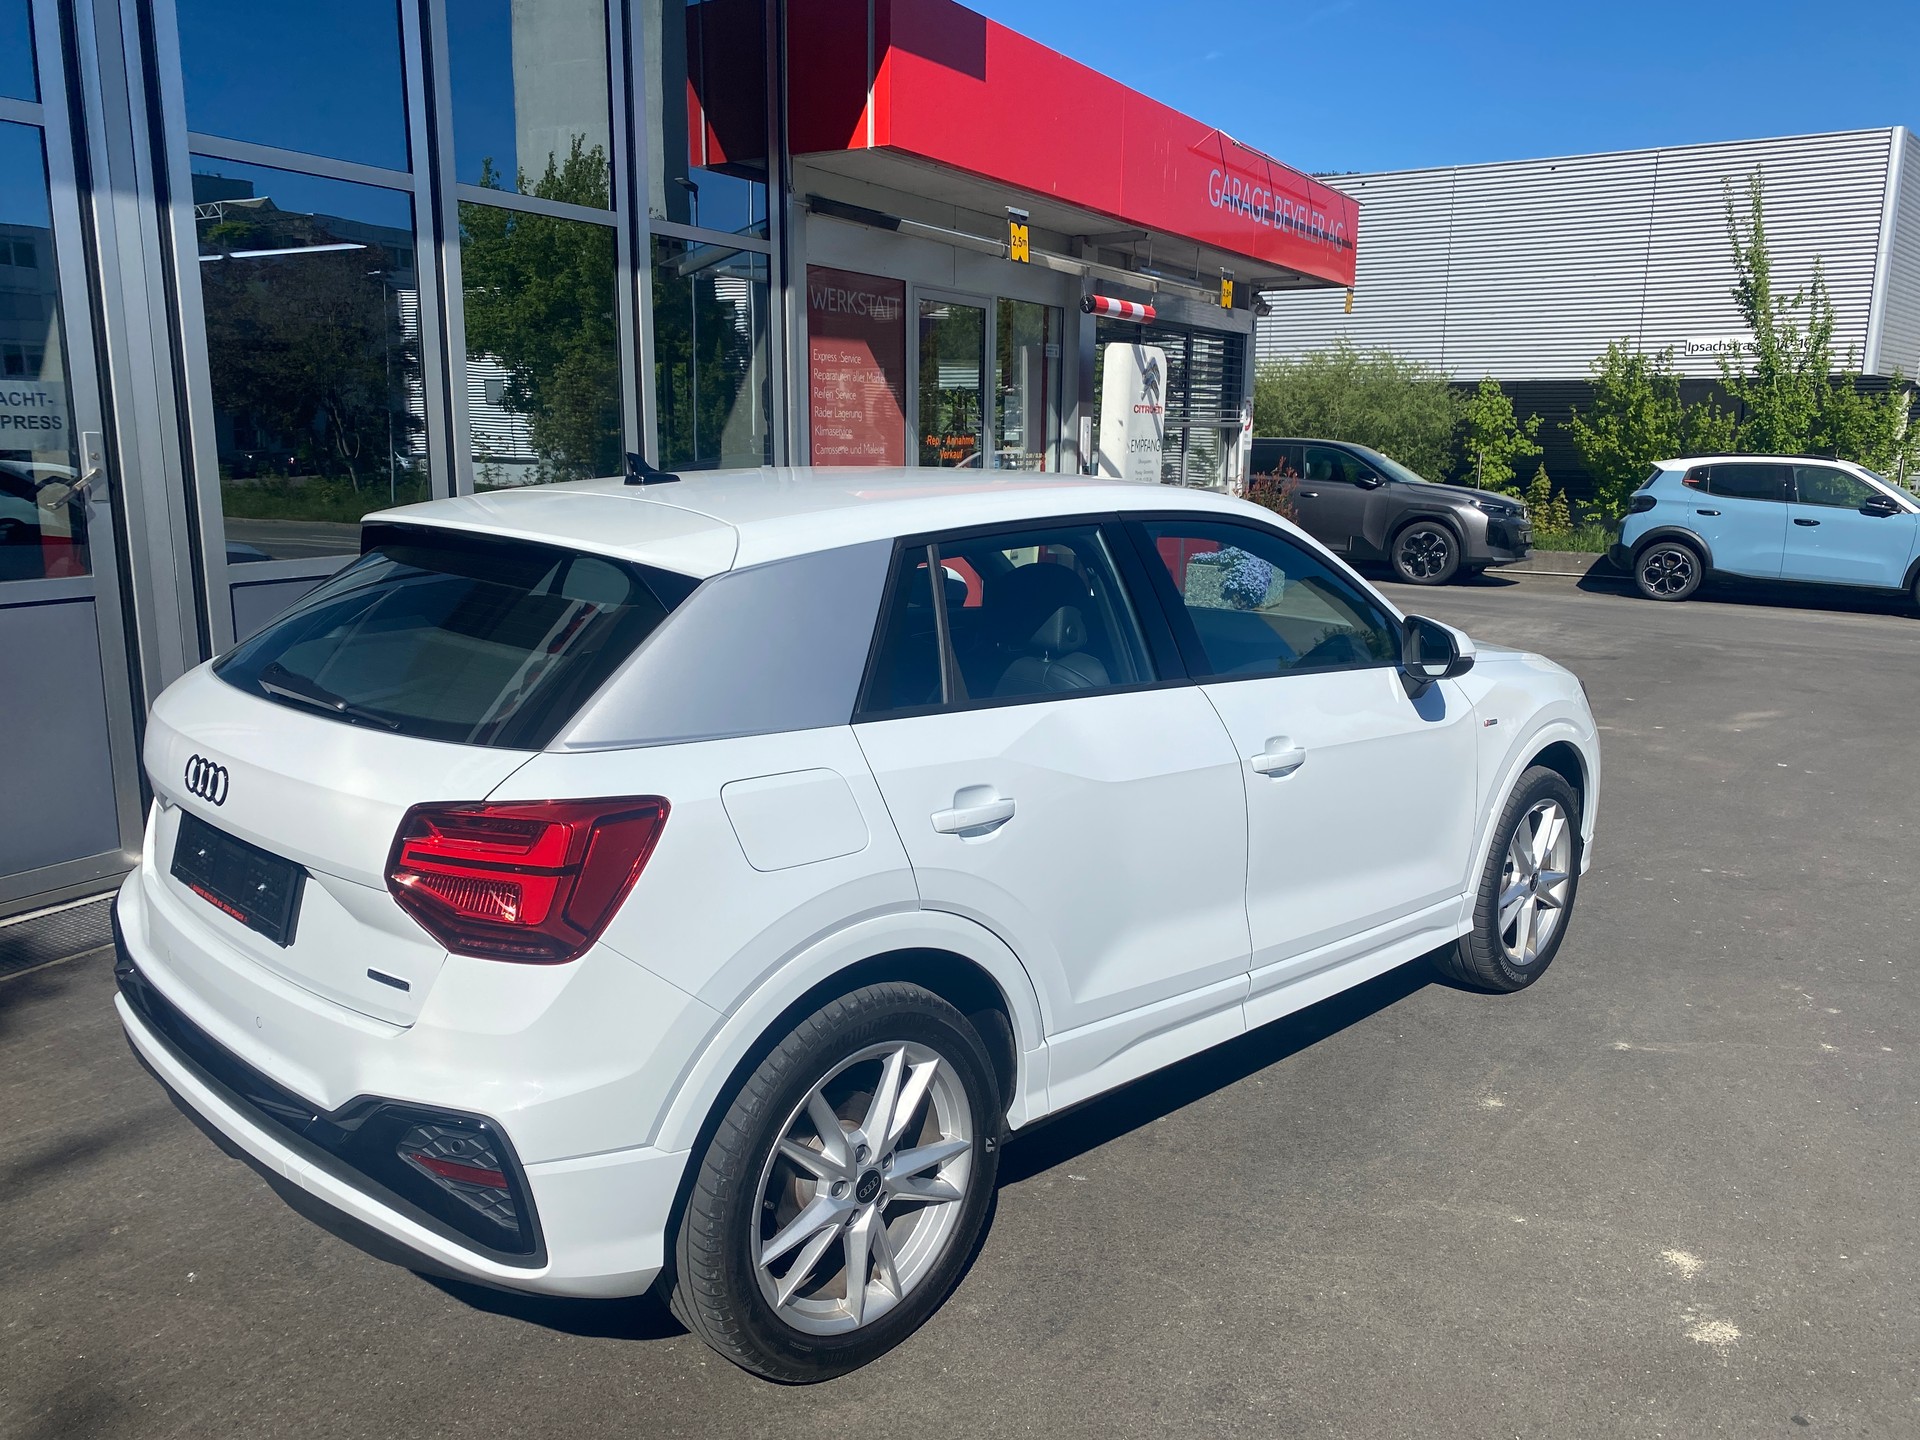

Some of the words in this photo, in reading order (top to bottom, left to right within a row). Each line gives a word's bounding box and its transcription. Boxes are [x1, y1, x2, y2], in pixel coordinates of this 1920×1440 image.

[1208, 169, 1271, 226] GARAGE
[1274, 195, 1325, 245] BEYELER
[1327, 219, 1344, 253] AG
[810, 285, 901, 321] WERKSTATT
[1688, 340, 1763, 354] Ipsachstrass
[813, 387, 833, 399] Reifen
[836, 387, 857, 400] Service
[835, 406, 863, 421] Lagerung
[850, 443, 862, 455] und
[1131, 438, 1161, 453] EMPFANG
